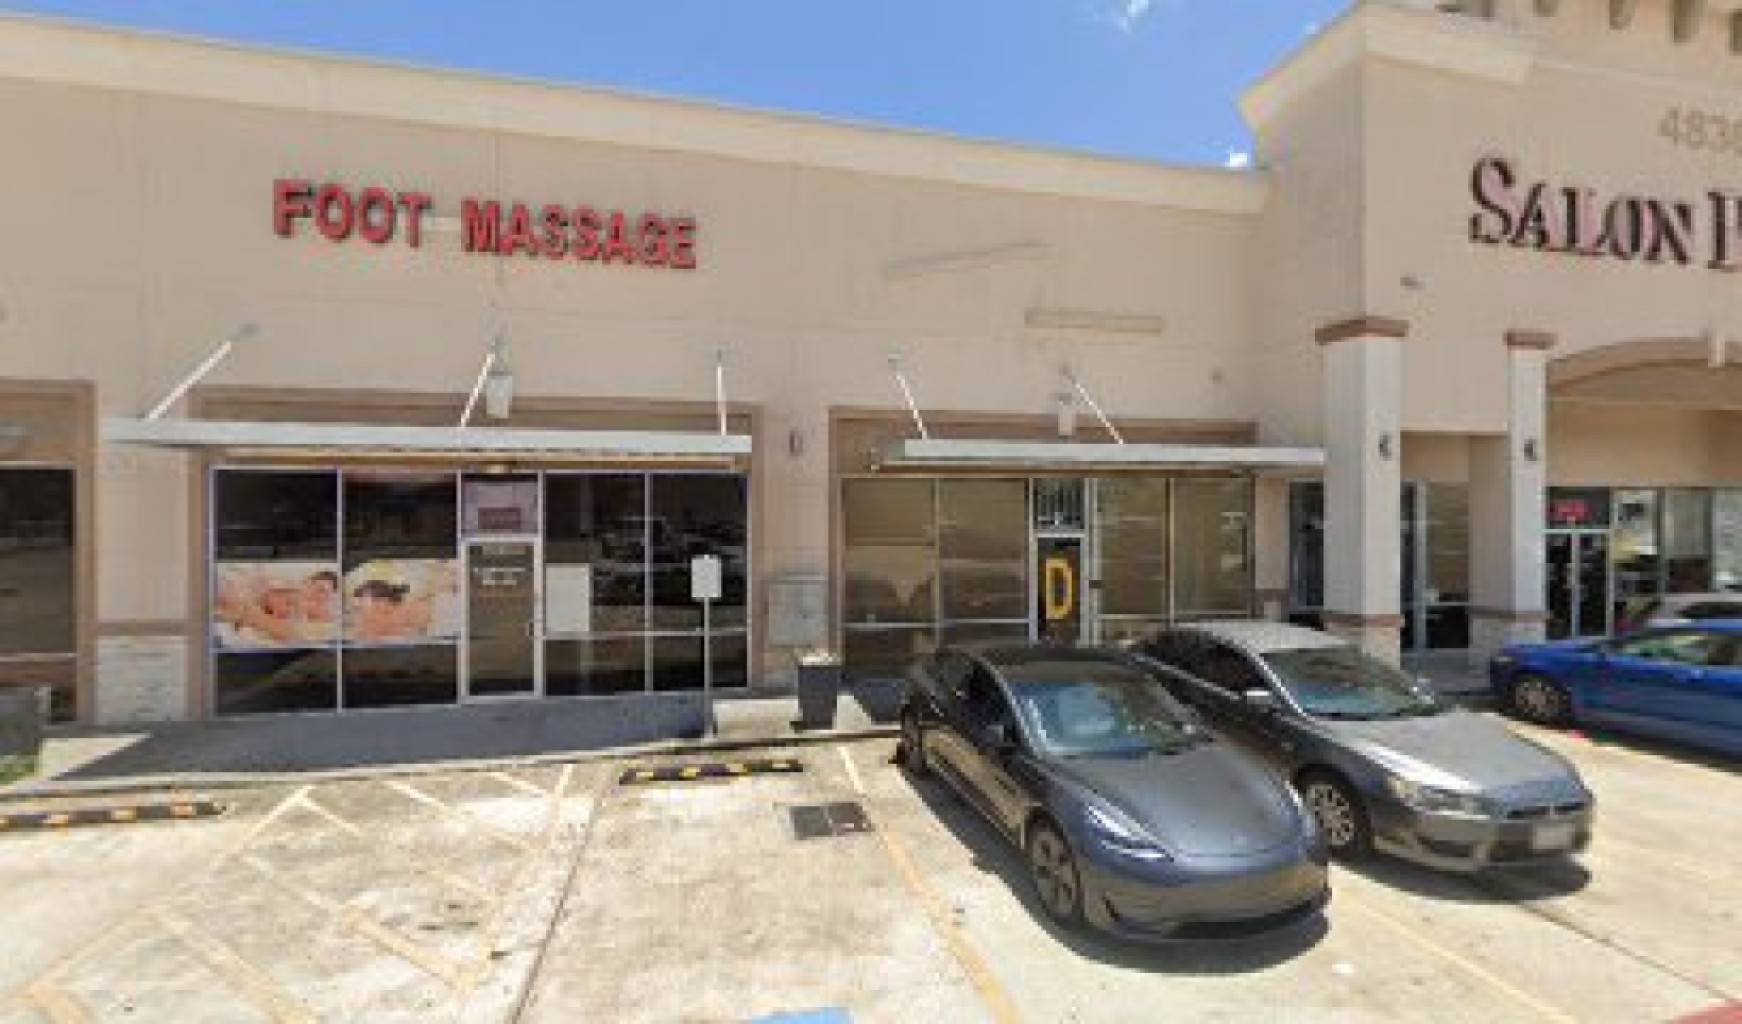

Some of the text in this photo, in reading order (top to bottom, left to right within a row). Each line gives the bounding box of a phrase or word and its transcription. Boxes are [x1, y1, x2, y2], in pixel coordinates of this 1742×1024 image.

[273, 179, 697, 269] FOOT MASSAGE
[1469, 157, 1693, 264] SALON
